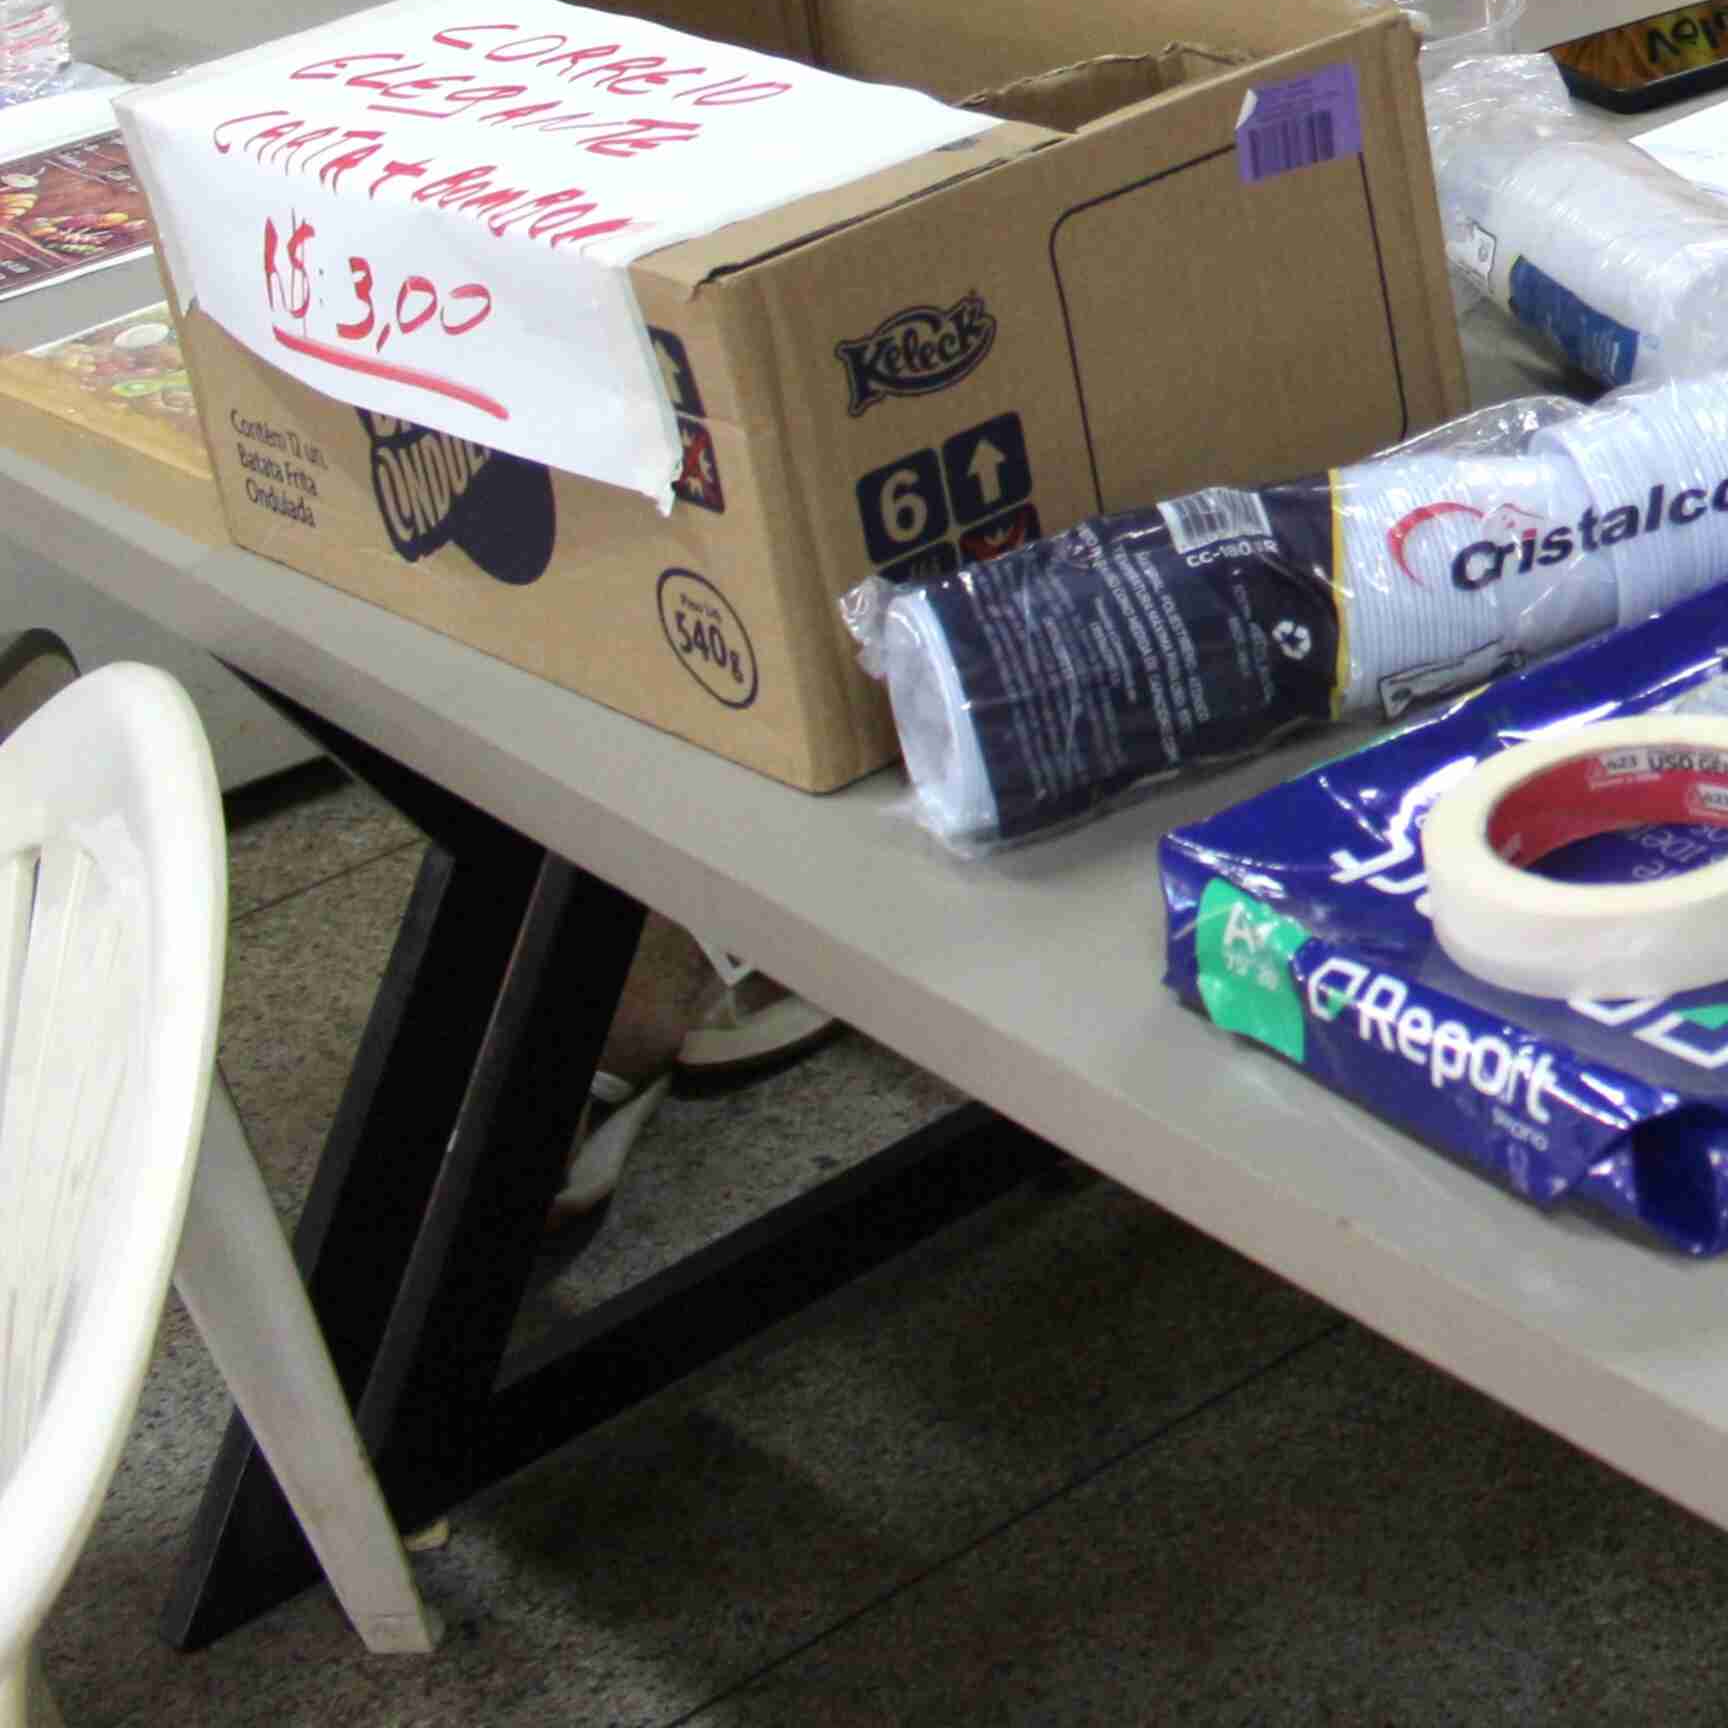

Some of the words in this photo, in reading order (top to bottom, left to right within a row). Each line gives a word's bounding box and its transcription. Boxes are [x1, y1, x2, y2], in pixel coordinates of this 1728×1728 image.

[290, 52, 700, 158] ELEGANTE
[433, 23, 792, 106] CORREIO
[213, 110, 386, 196] CARTA
[336, 255, 492, 353] 3,00
[837, 301, 996, 412] Keleck
[378, 432, 490, 542] ONDU
[878, 467, 929, 542] 6
[1359, 979, 1563, 1128] Report
